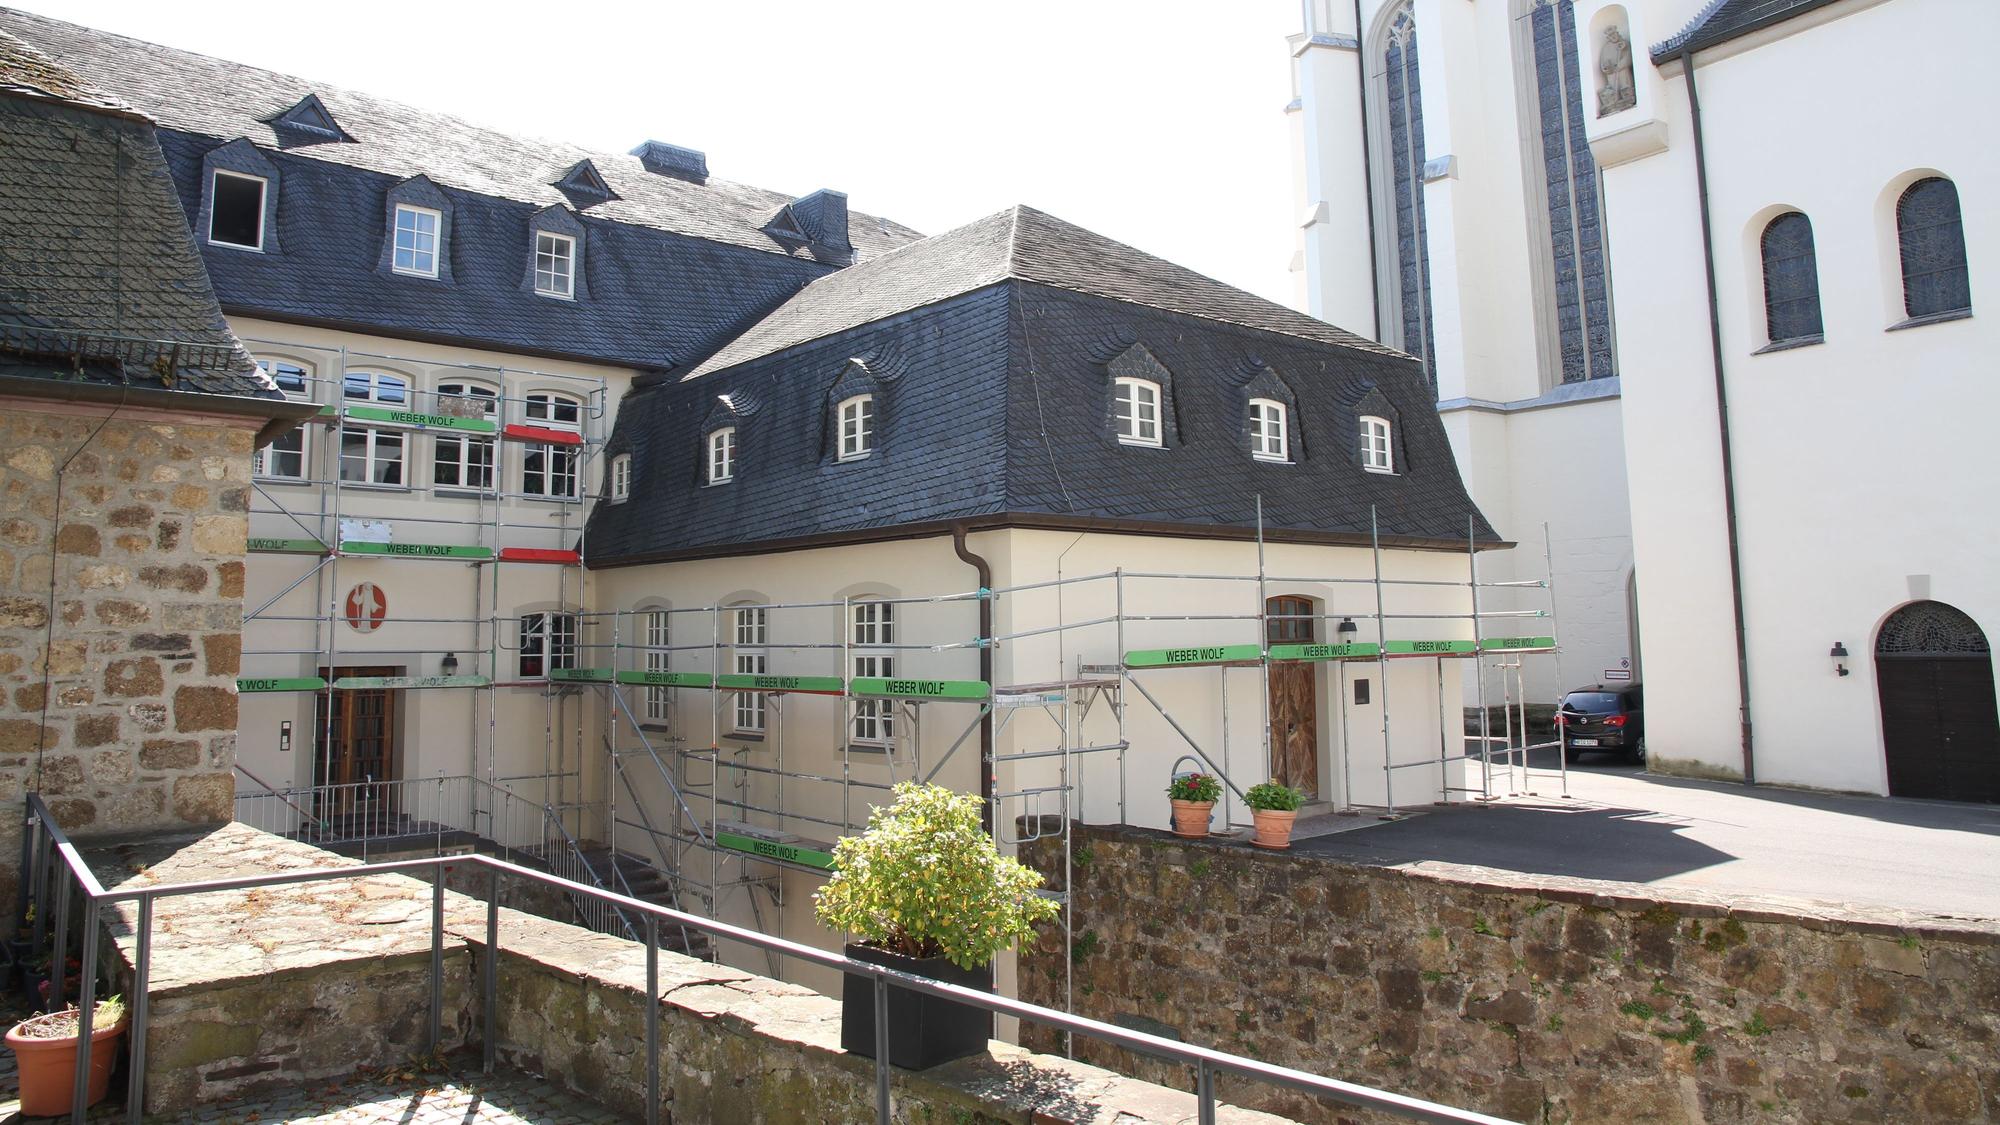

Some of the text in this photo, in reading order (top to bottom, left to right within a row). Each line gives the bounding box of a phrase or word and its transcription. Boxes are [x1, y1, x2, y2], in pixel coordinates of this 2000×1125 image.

[390, 411, 455, 427] WEBER WOLF
[254, 539, 289, 550] WOLF
[386, 543, 453, 555] WEBER WOLF
[1412, 641, 1452, 652] WEBER WOLF
[1502, 638, 1536, 648] WEBER WOLF
[1165, 647, 1225, 663] WEBER WOLF
[1303, 644, 1351, 657] WEBER WOLF
[644, 672, 679, 684] WEBER WOLF
[754, 676, 800, 689] WEBER WOLF
[245, 680, 279, 690] WOLF
[885, 680, 945, 696] WEBER WOLF
[753, 841, 799, 860] WEBER WOLF
